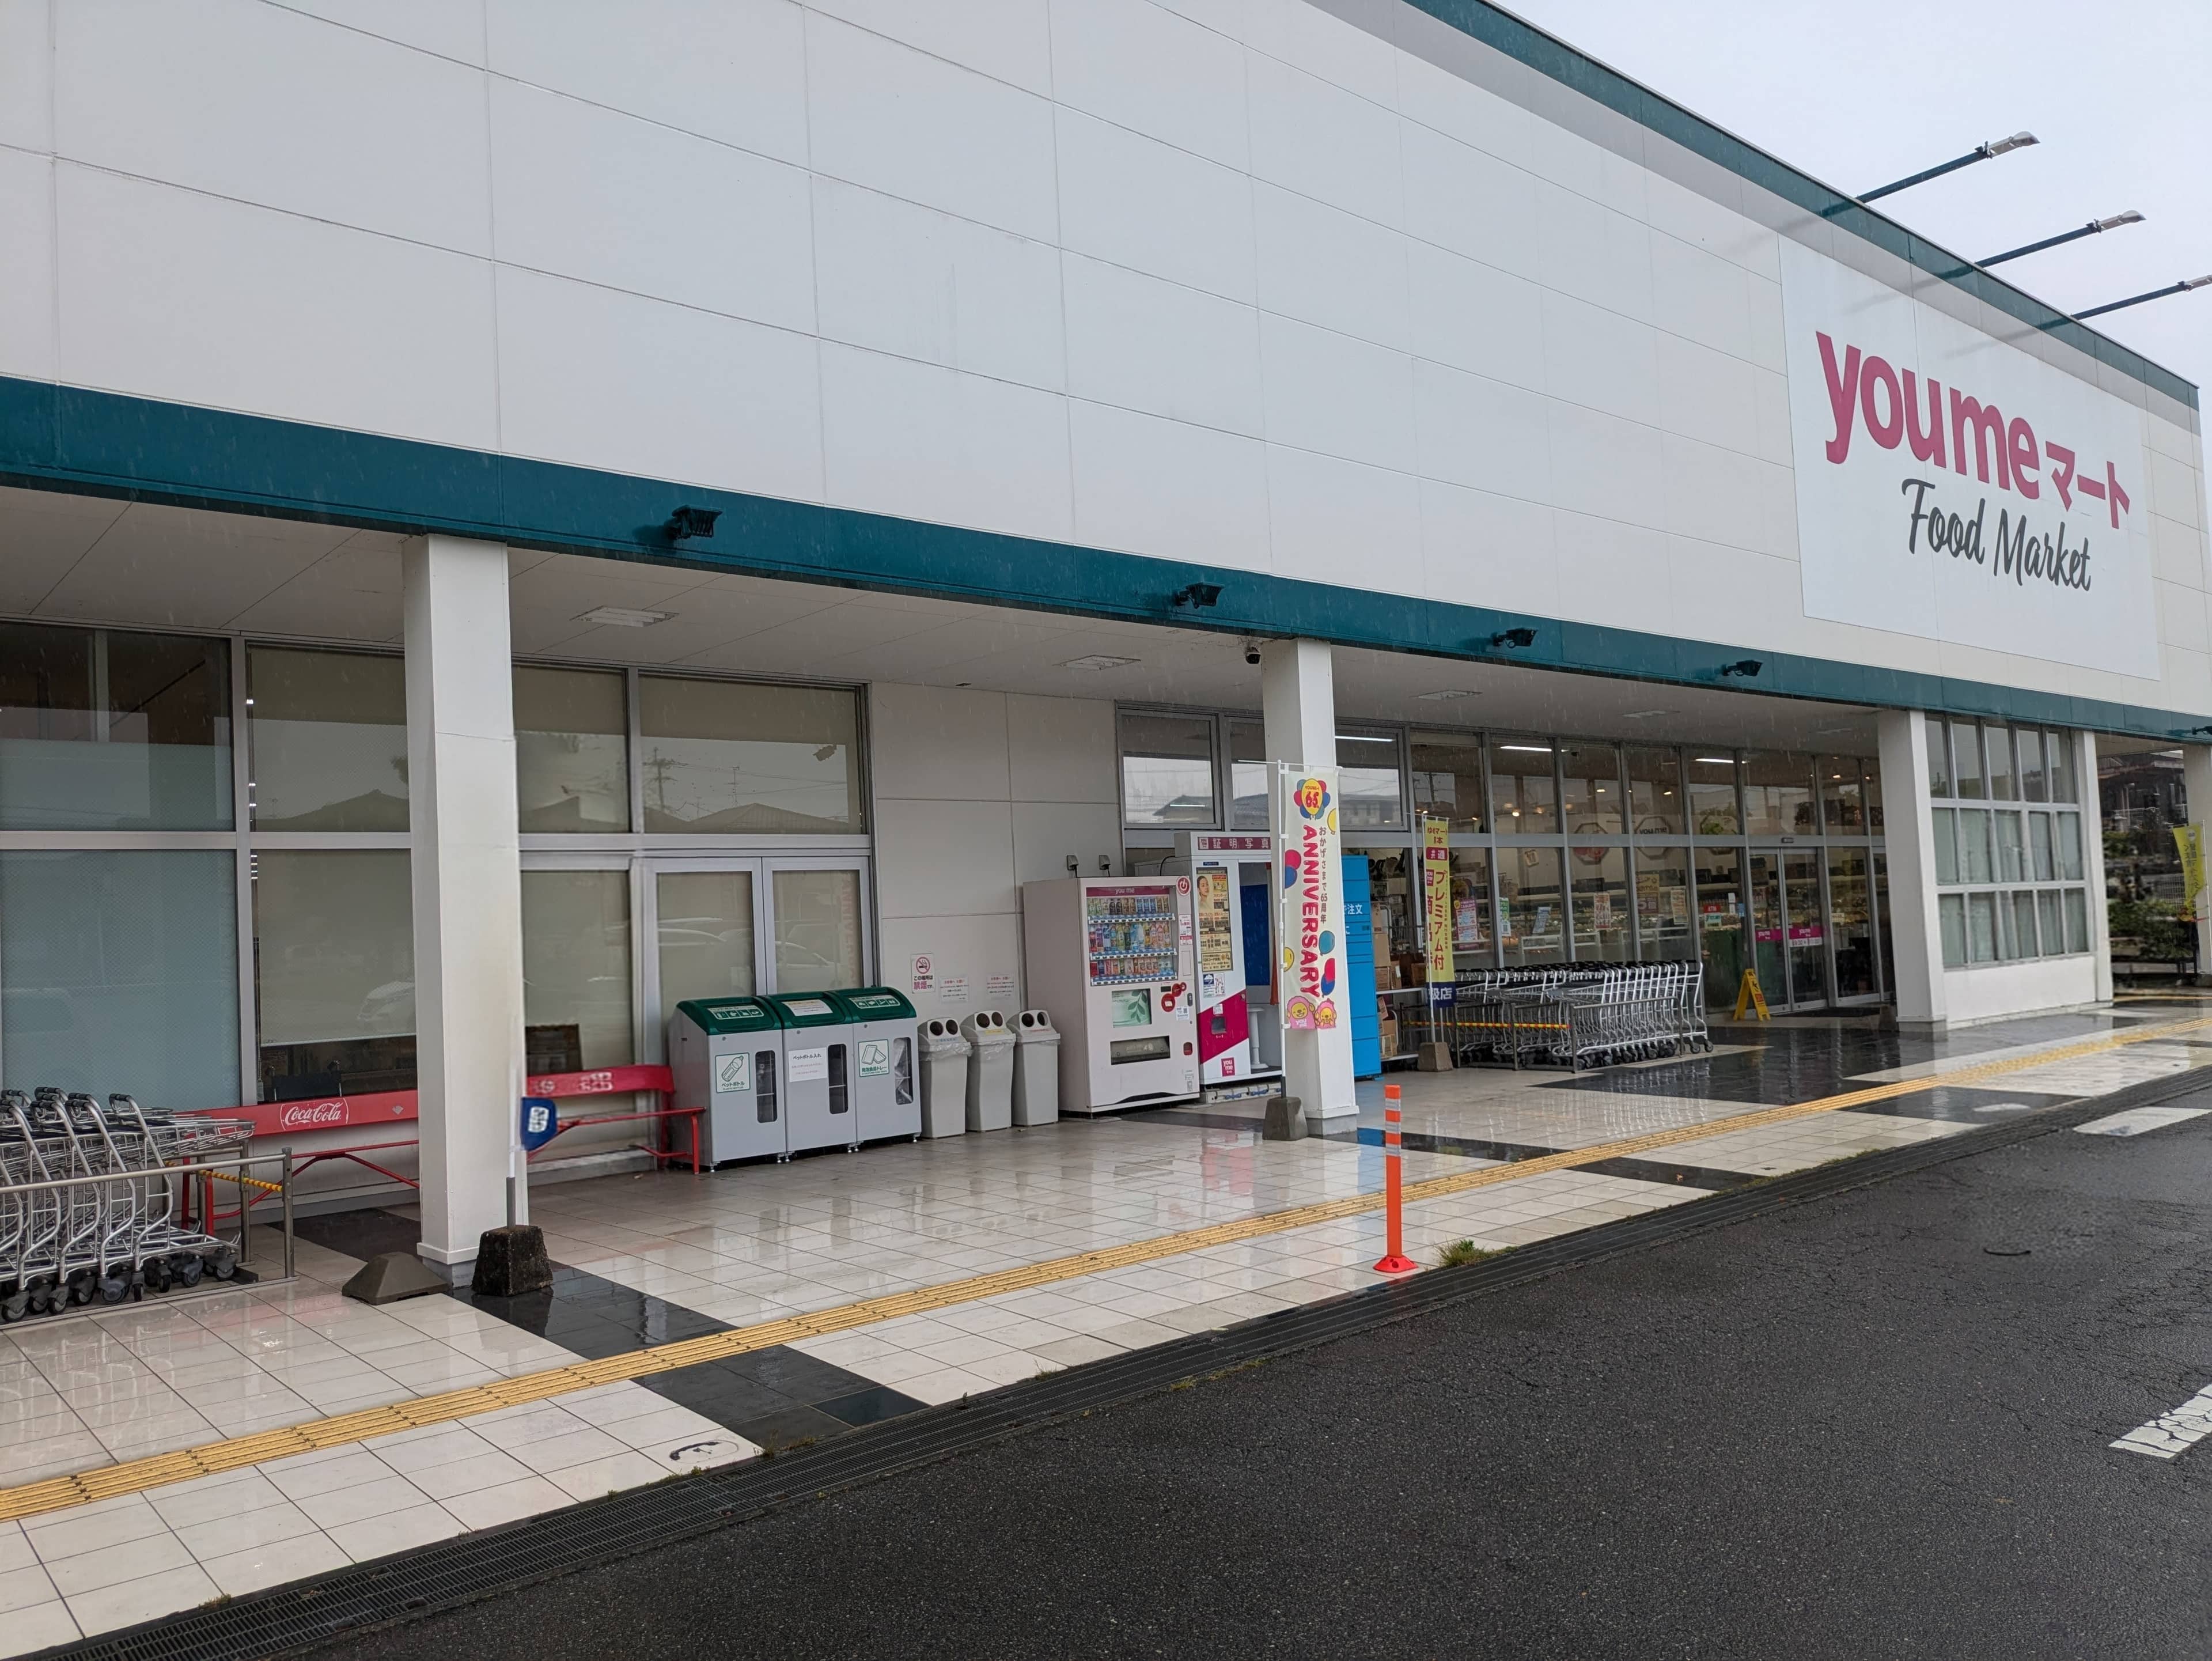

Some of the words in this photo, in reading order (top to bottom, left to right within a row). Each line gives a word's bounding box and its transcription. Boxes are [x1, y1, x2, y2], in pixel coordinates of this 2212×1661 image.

[1901, 478, 1985, 565] Food
[1993, 508, 2091, 591] Market
[1213, 838, 1269, 849] 証明写真
[1300, 824, 1320, 998] ANNIVERSARY
[1434, 869, 1447, 970] プレミアム付
